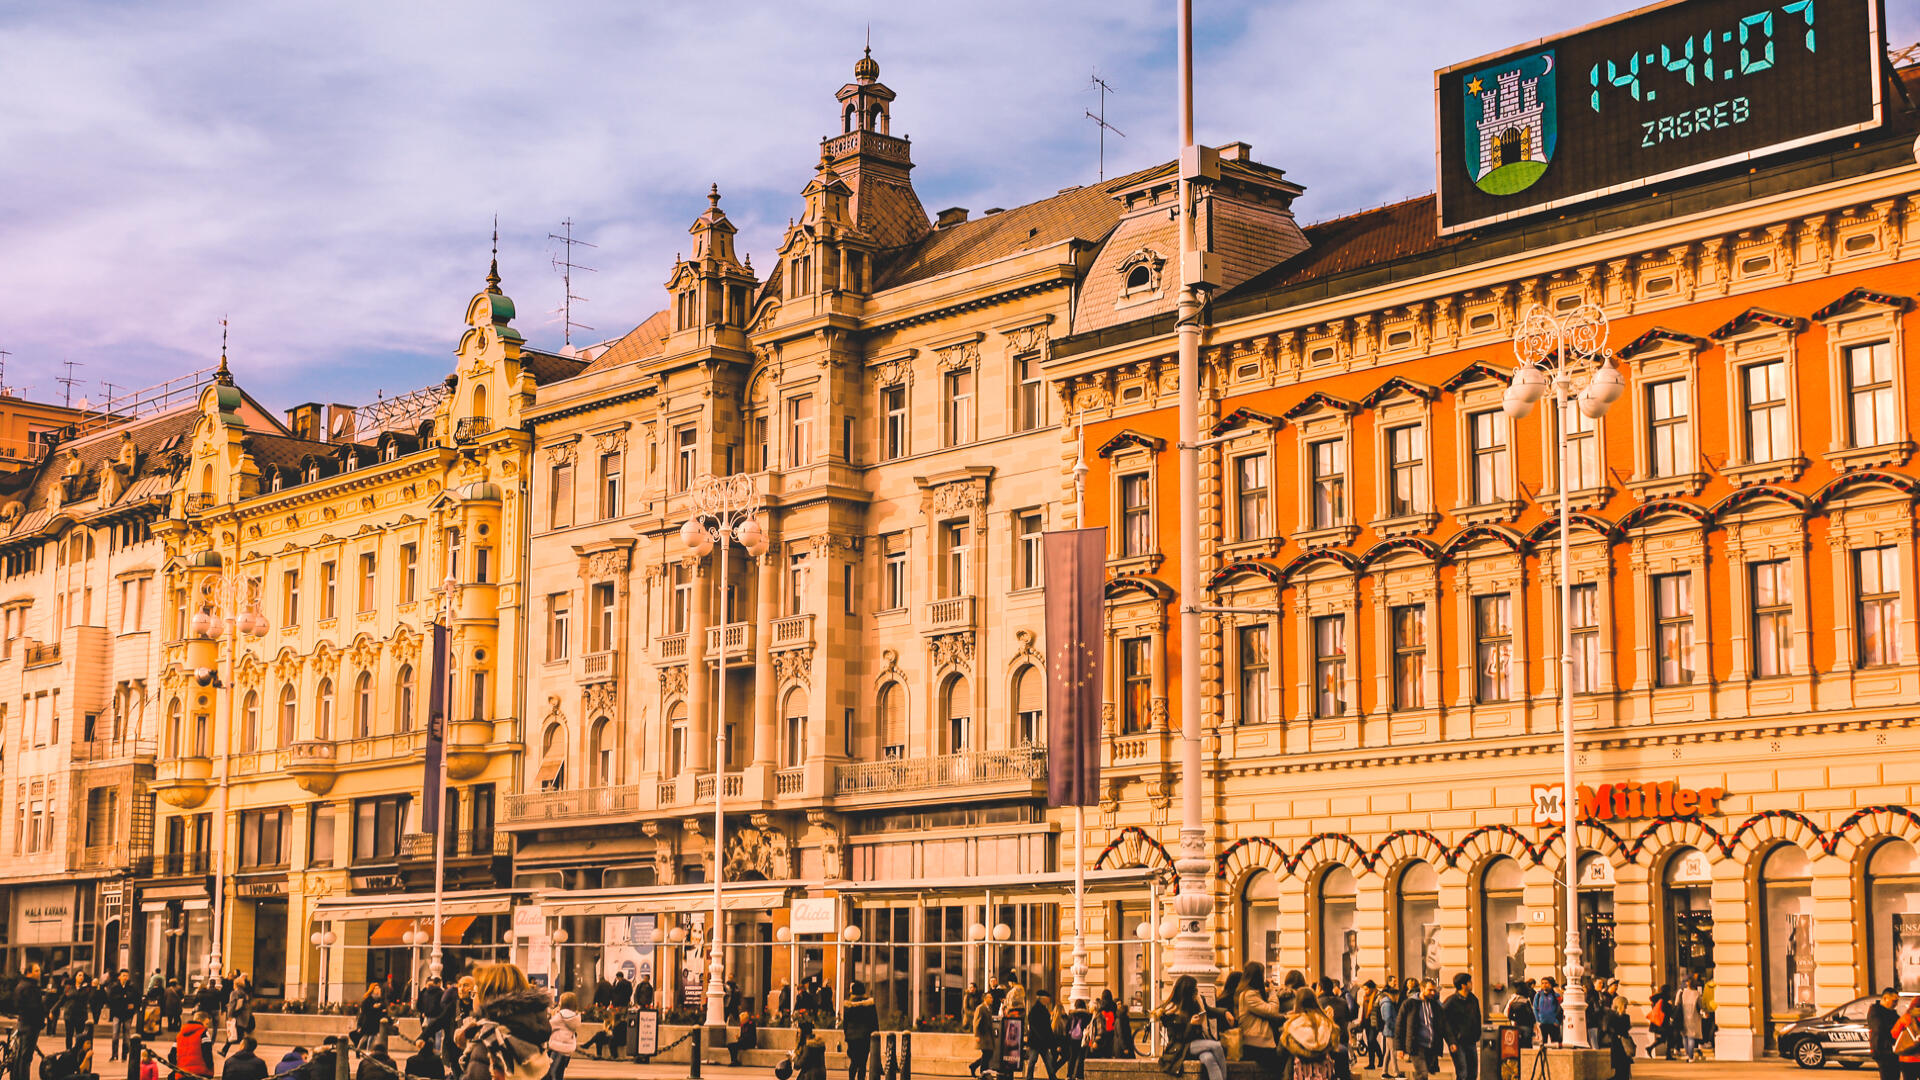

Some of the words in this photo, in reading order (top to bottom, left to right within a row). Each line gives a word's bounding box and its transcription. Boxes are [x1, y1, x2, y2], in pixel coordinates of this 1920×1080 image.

[1589, 0, 1816, 113] 14:41:07
[1641, 97, 1750, 147] ZAGREB
[1575, 781, 1724, 821] Müller
[25, 907, 41, 917] MALA
[44, 906, 68, 916] KAVANA
[1828, 1031, 1860, 1043] KLEMM
